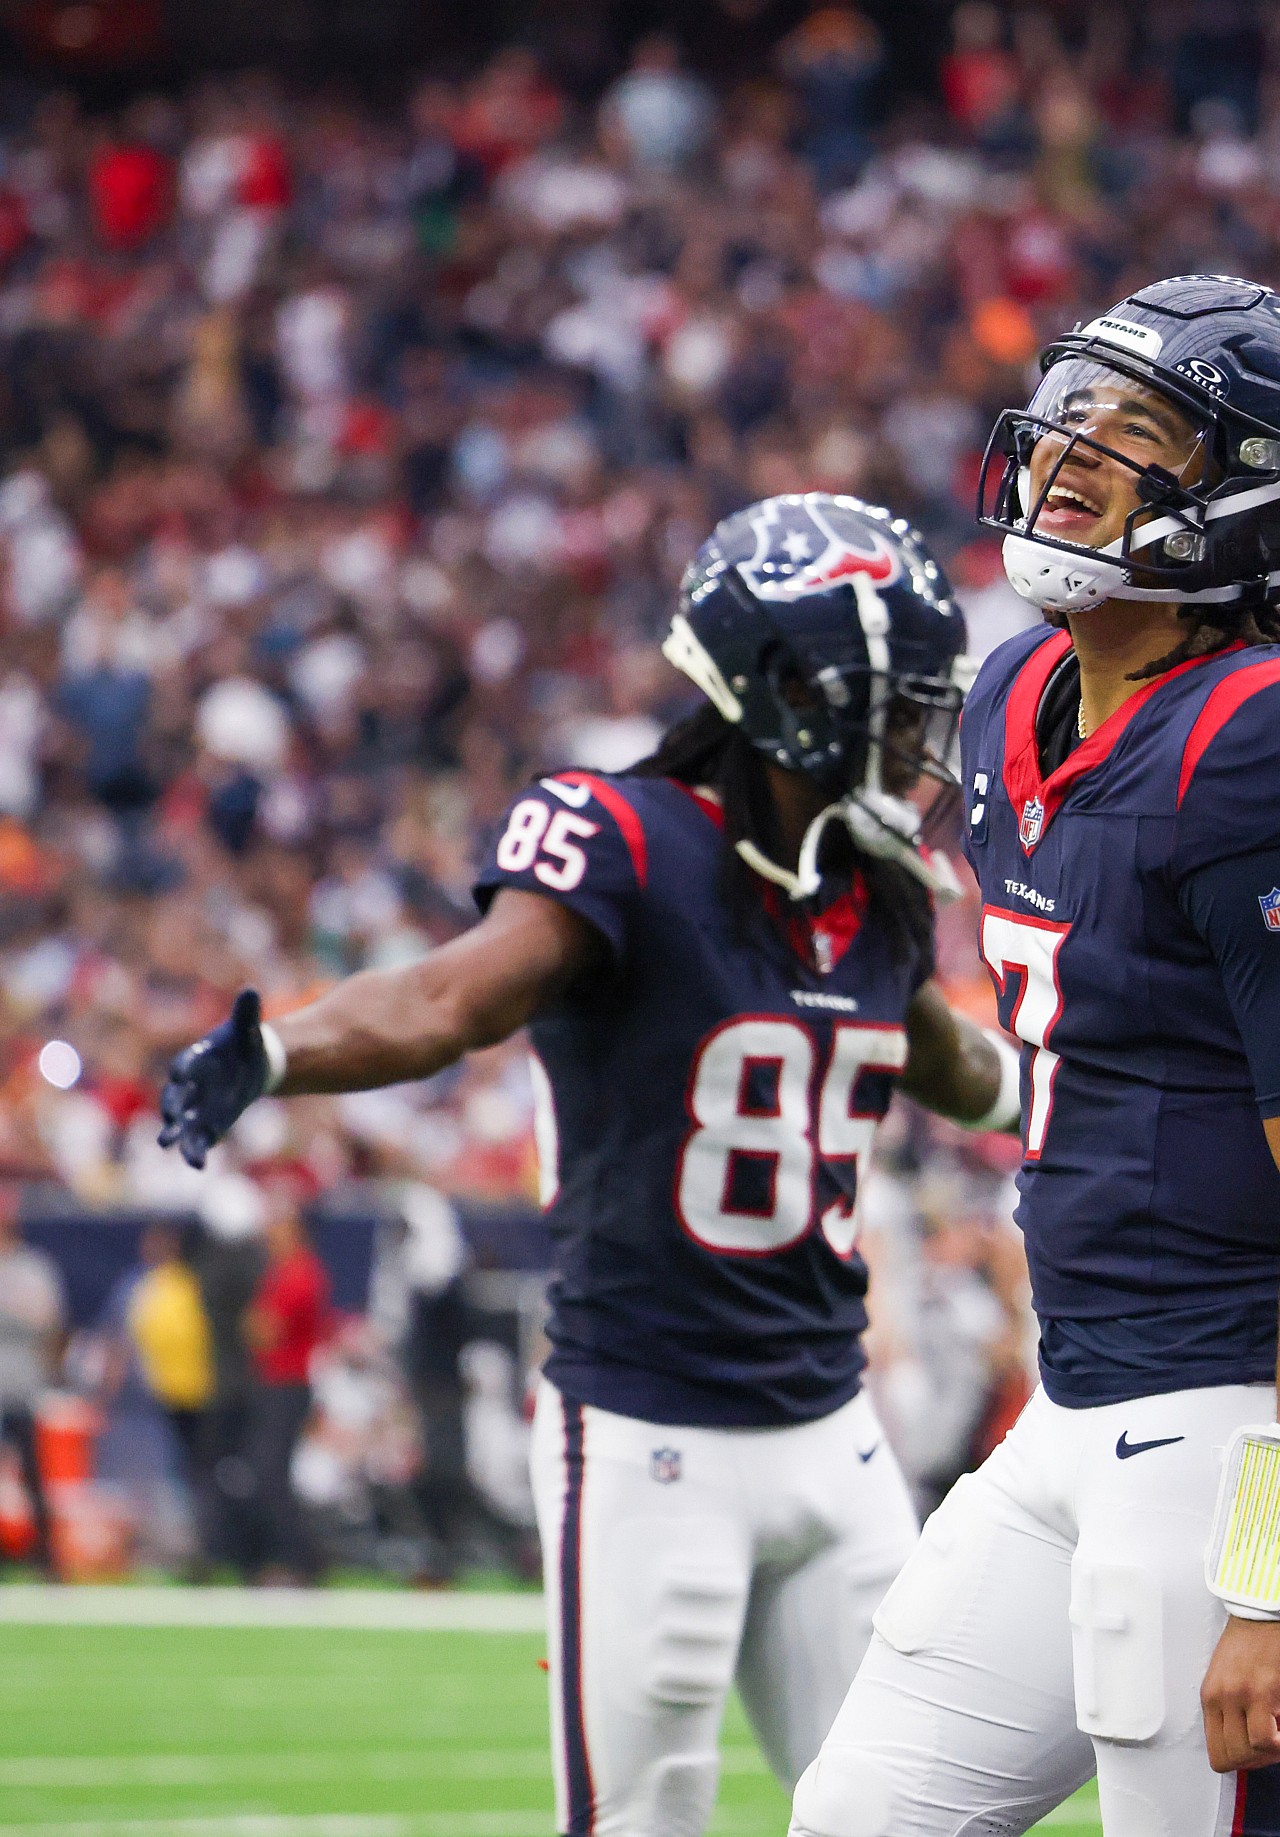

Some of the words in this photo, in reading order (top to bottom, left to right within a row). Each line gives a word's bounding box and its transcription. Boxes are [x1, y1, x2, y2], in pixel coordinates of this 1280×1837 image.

[1099, 320, 1148, 339] TEXANS
[1176, 364, 1224, 396] OAKLEY
[496, 798, 602, 892] 85
[1003, 879, 1056, 912] TEXANS
[978, 903, 1073, 1160] 7
[673, 1013, 908, 1262] 85
